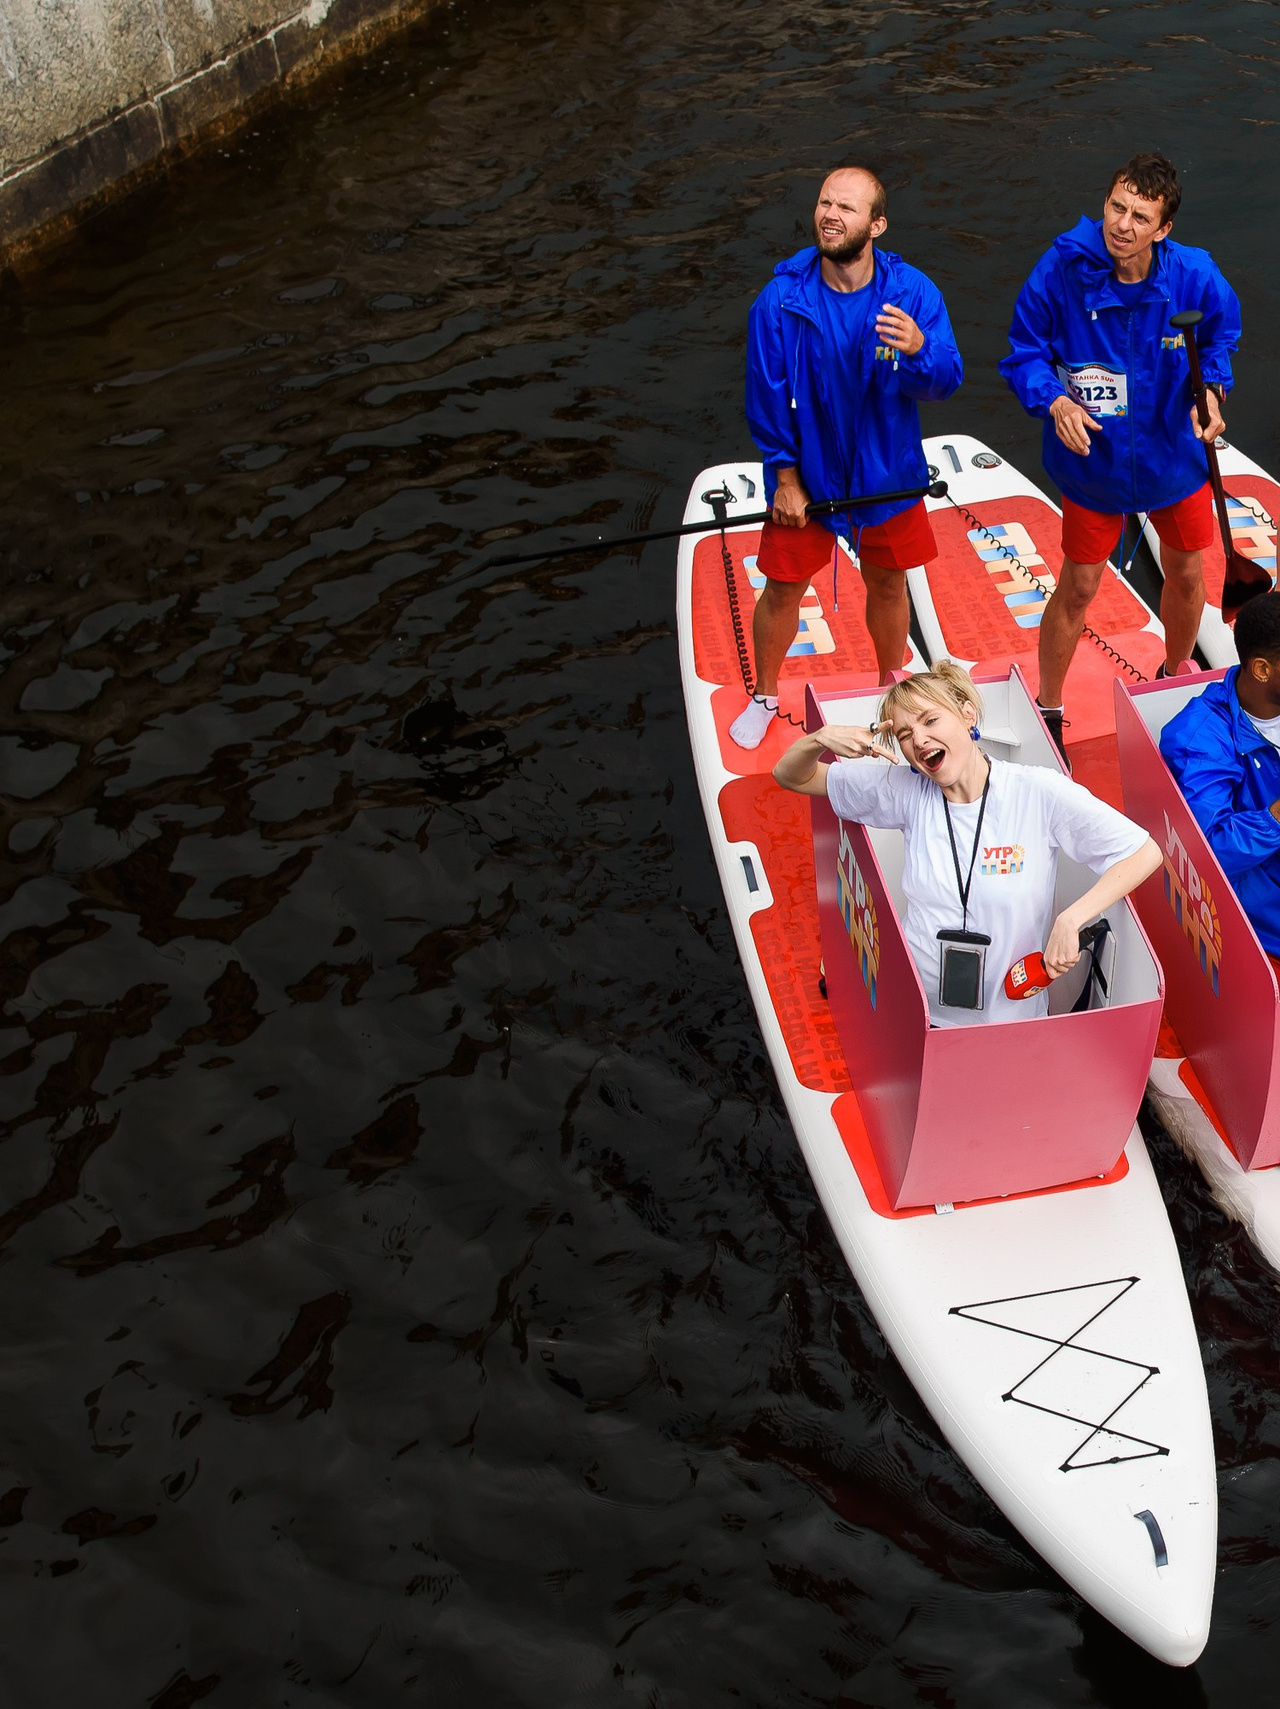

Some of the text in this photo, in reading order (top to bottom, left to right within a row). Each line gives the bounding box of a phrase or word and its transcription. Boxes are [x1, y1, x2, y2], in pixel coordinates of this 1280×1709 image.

[1161, 333, 1185, 349] ТН
[1101, 375, 1115, 383] SUP
[838, 818, 873, 948] УТРО
[982, 859, 1023, 875] ТНТ
[983, 845, 1024, 860] УТРО
[1162, 809, 1214, 938] УТРО
[837, 858, 877, 1011] ТНТ
[1164, 853, 1219, 997] ТНТ
